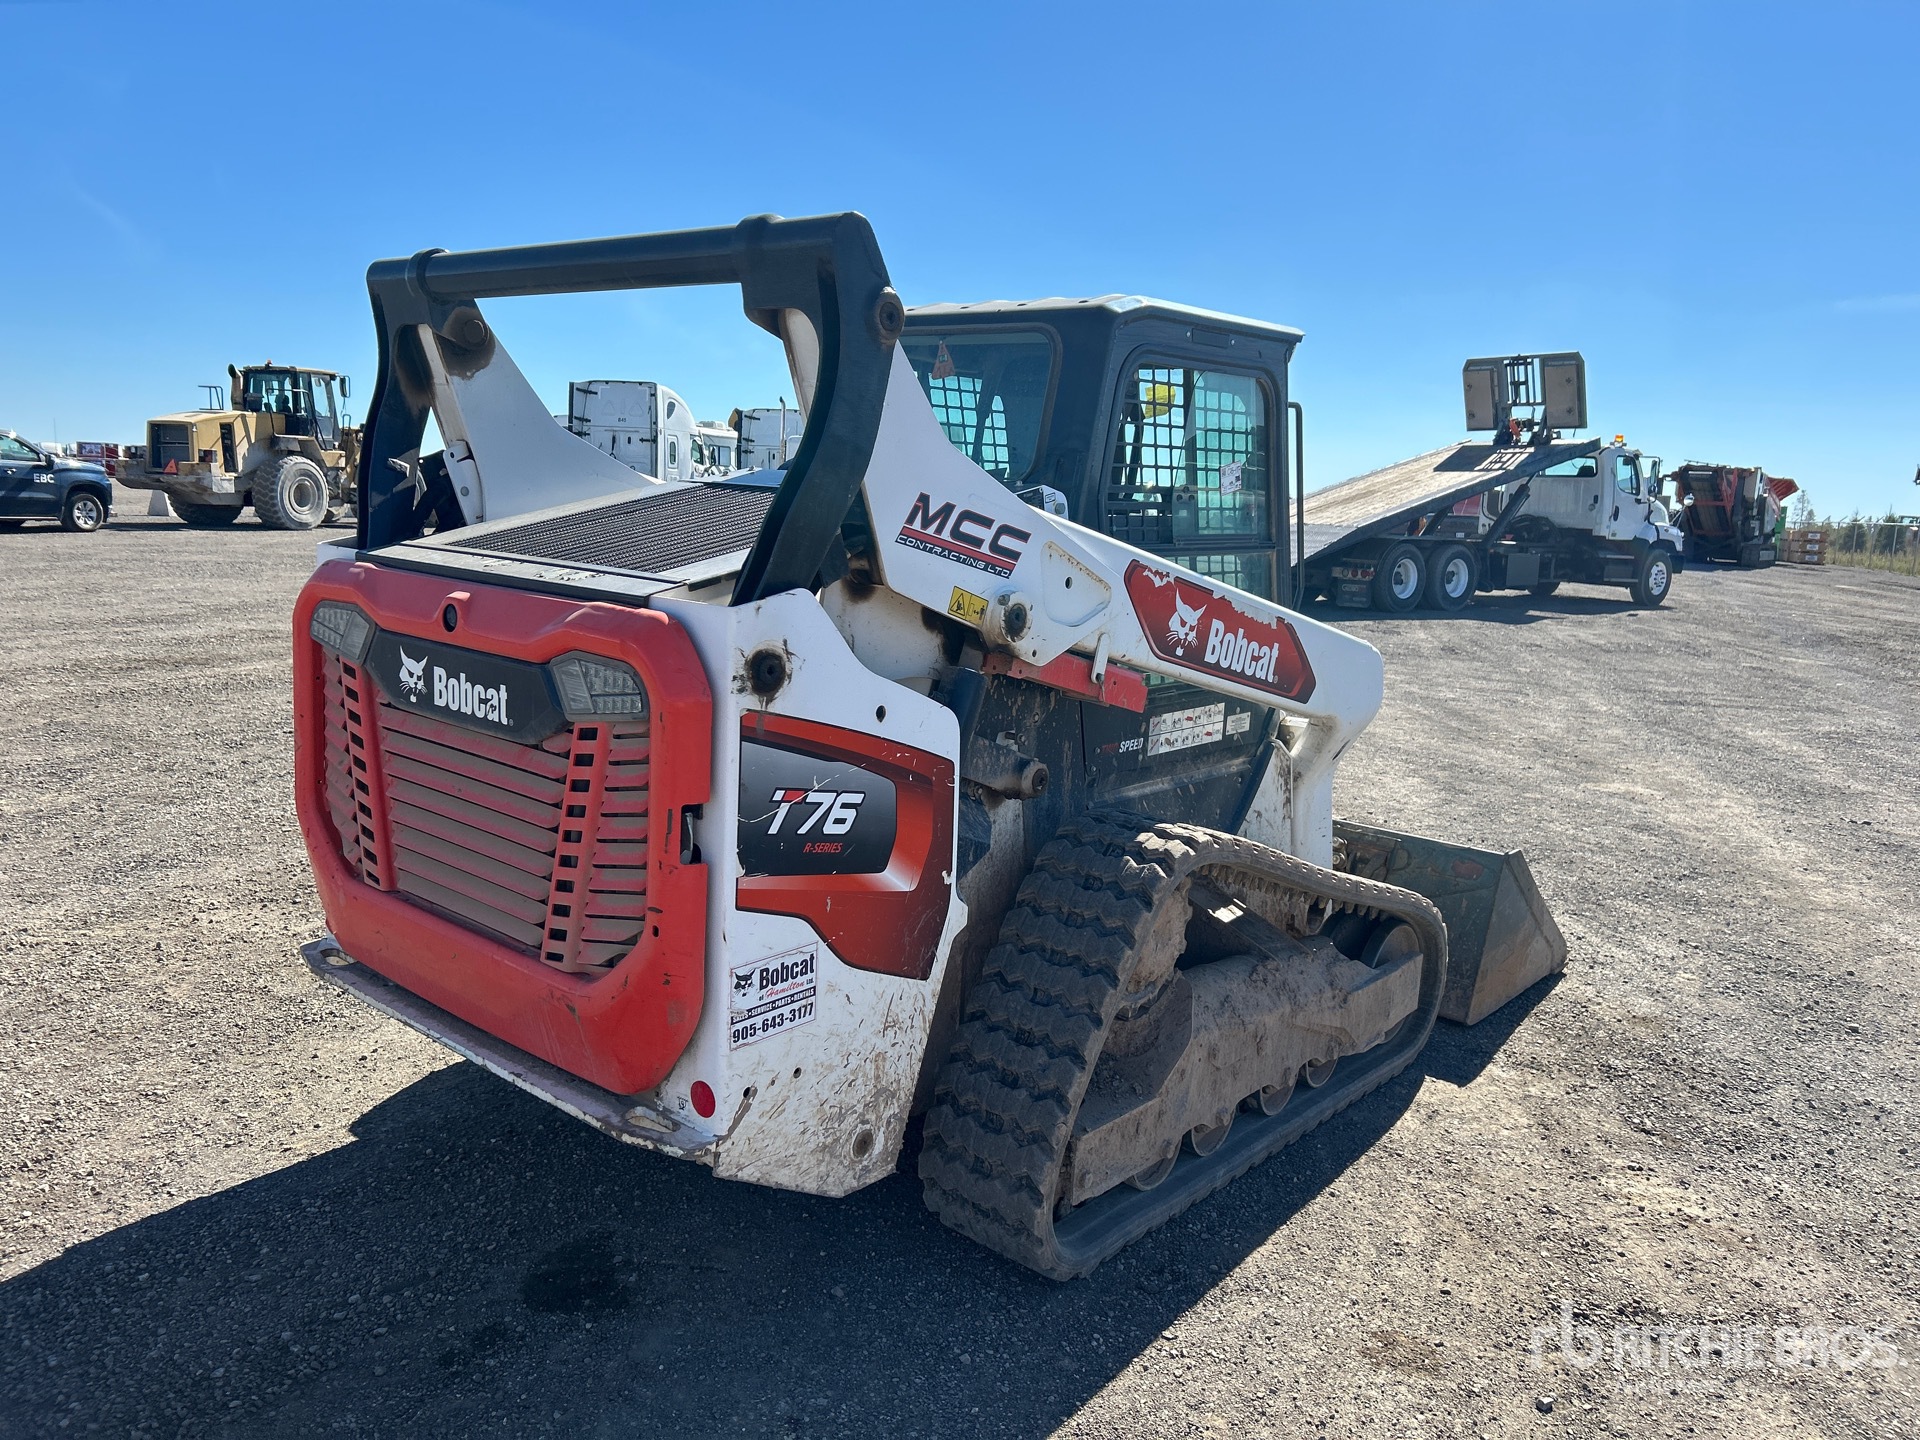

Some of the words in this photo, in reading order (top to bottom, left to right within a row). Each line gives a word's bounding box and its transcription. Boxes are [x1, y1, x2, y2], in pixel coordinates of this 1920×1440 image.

[33, 473, 55, 483] EBC
[904, 492, 1032, 562] MCC
[896, 534, 986, 570] CONTRACTING
[1204, 618, 1279, 683] Bobcat
[433, 666, 508, 726] Bobcat
[1119, 737, 1144, 753] SPEED
[803, 842, 843, 853] R-SERIES
[759, 953, 815, 991] Bobcat
[765, 981, 805, 999] Hamilton
[732, 1003, 814, 1043] 905-643-3177
